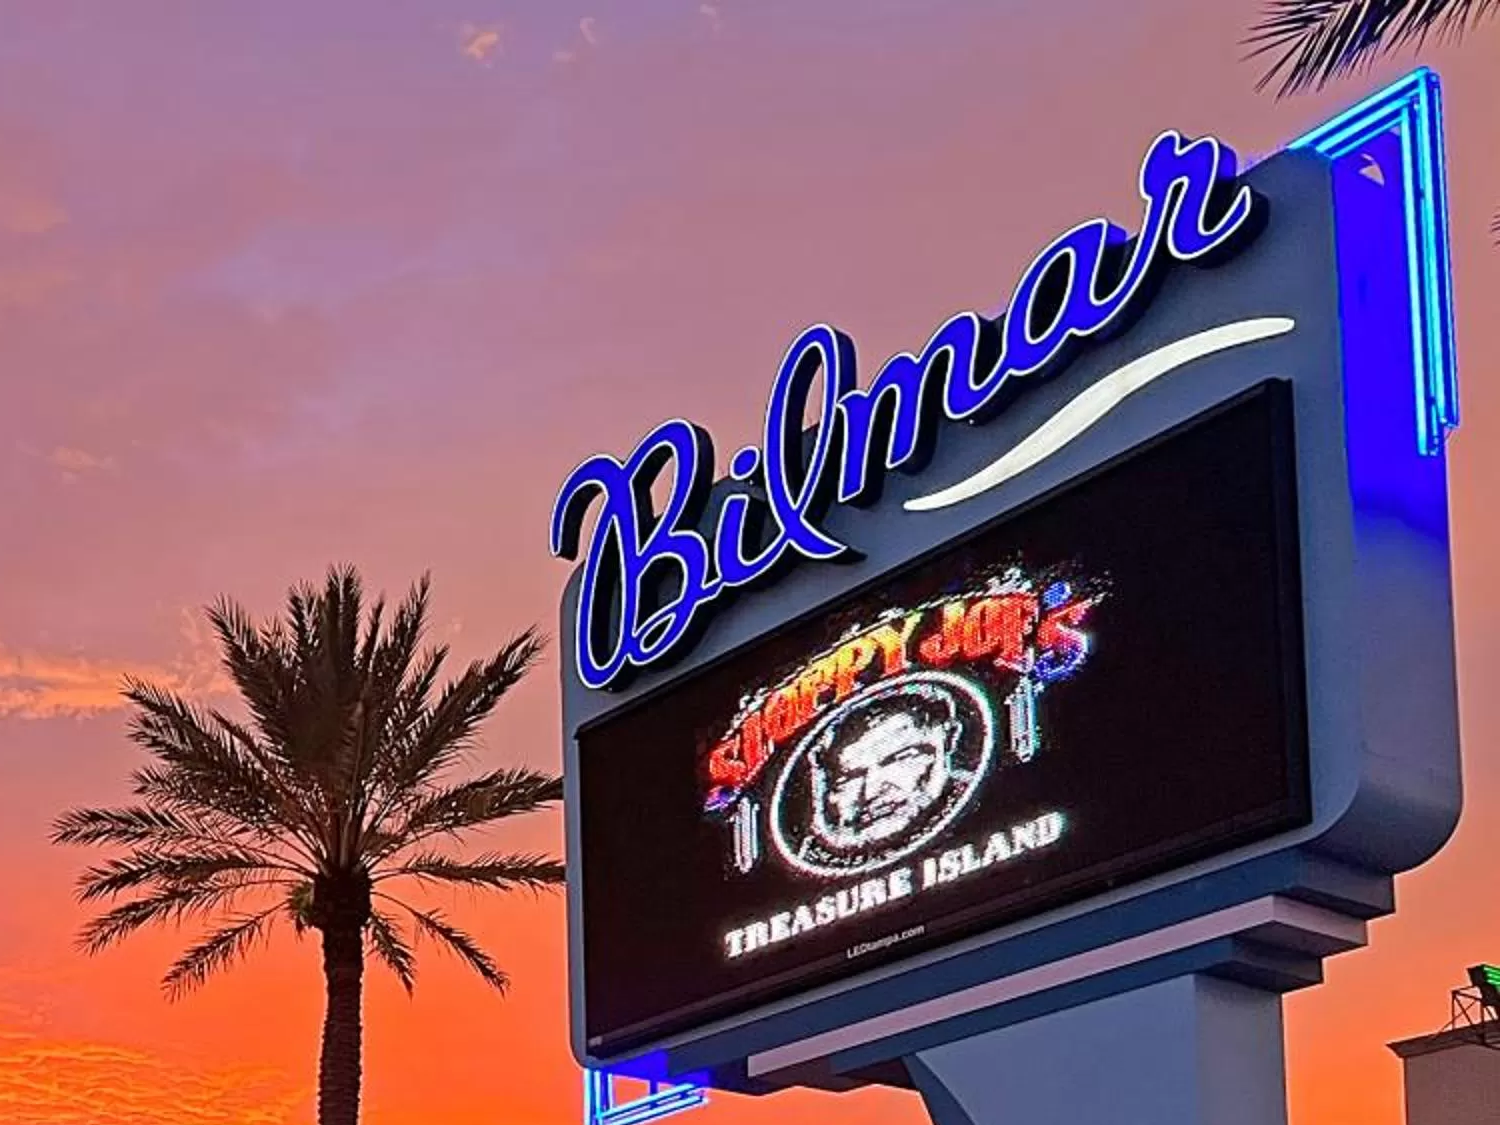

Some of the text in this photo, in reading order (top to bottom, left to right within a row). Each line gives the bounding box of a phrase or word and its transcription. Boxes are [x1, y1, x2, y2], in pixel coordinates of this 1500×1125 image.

[550, 129, 1252, 689] Bilmar
[724, 811, 1064, 958] TREASURE ISLAND
